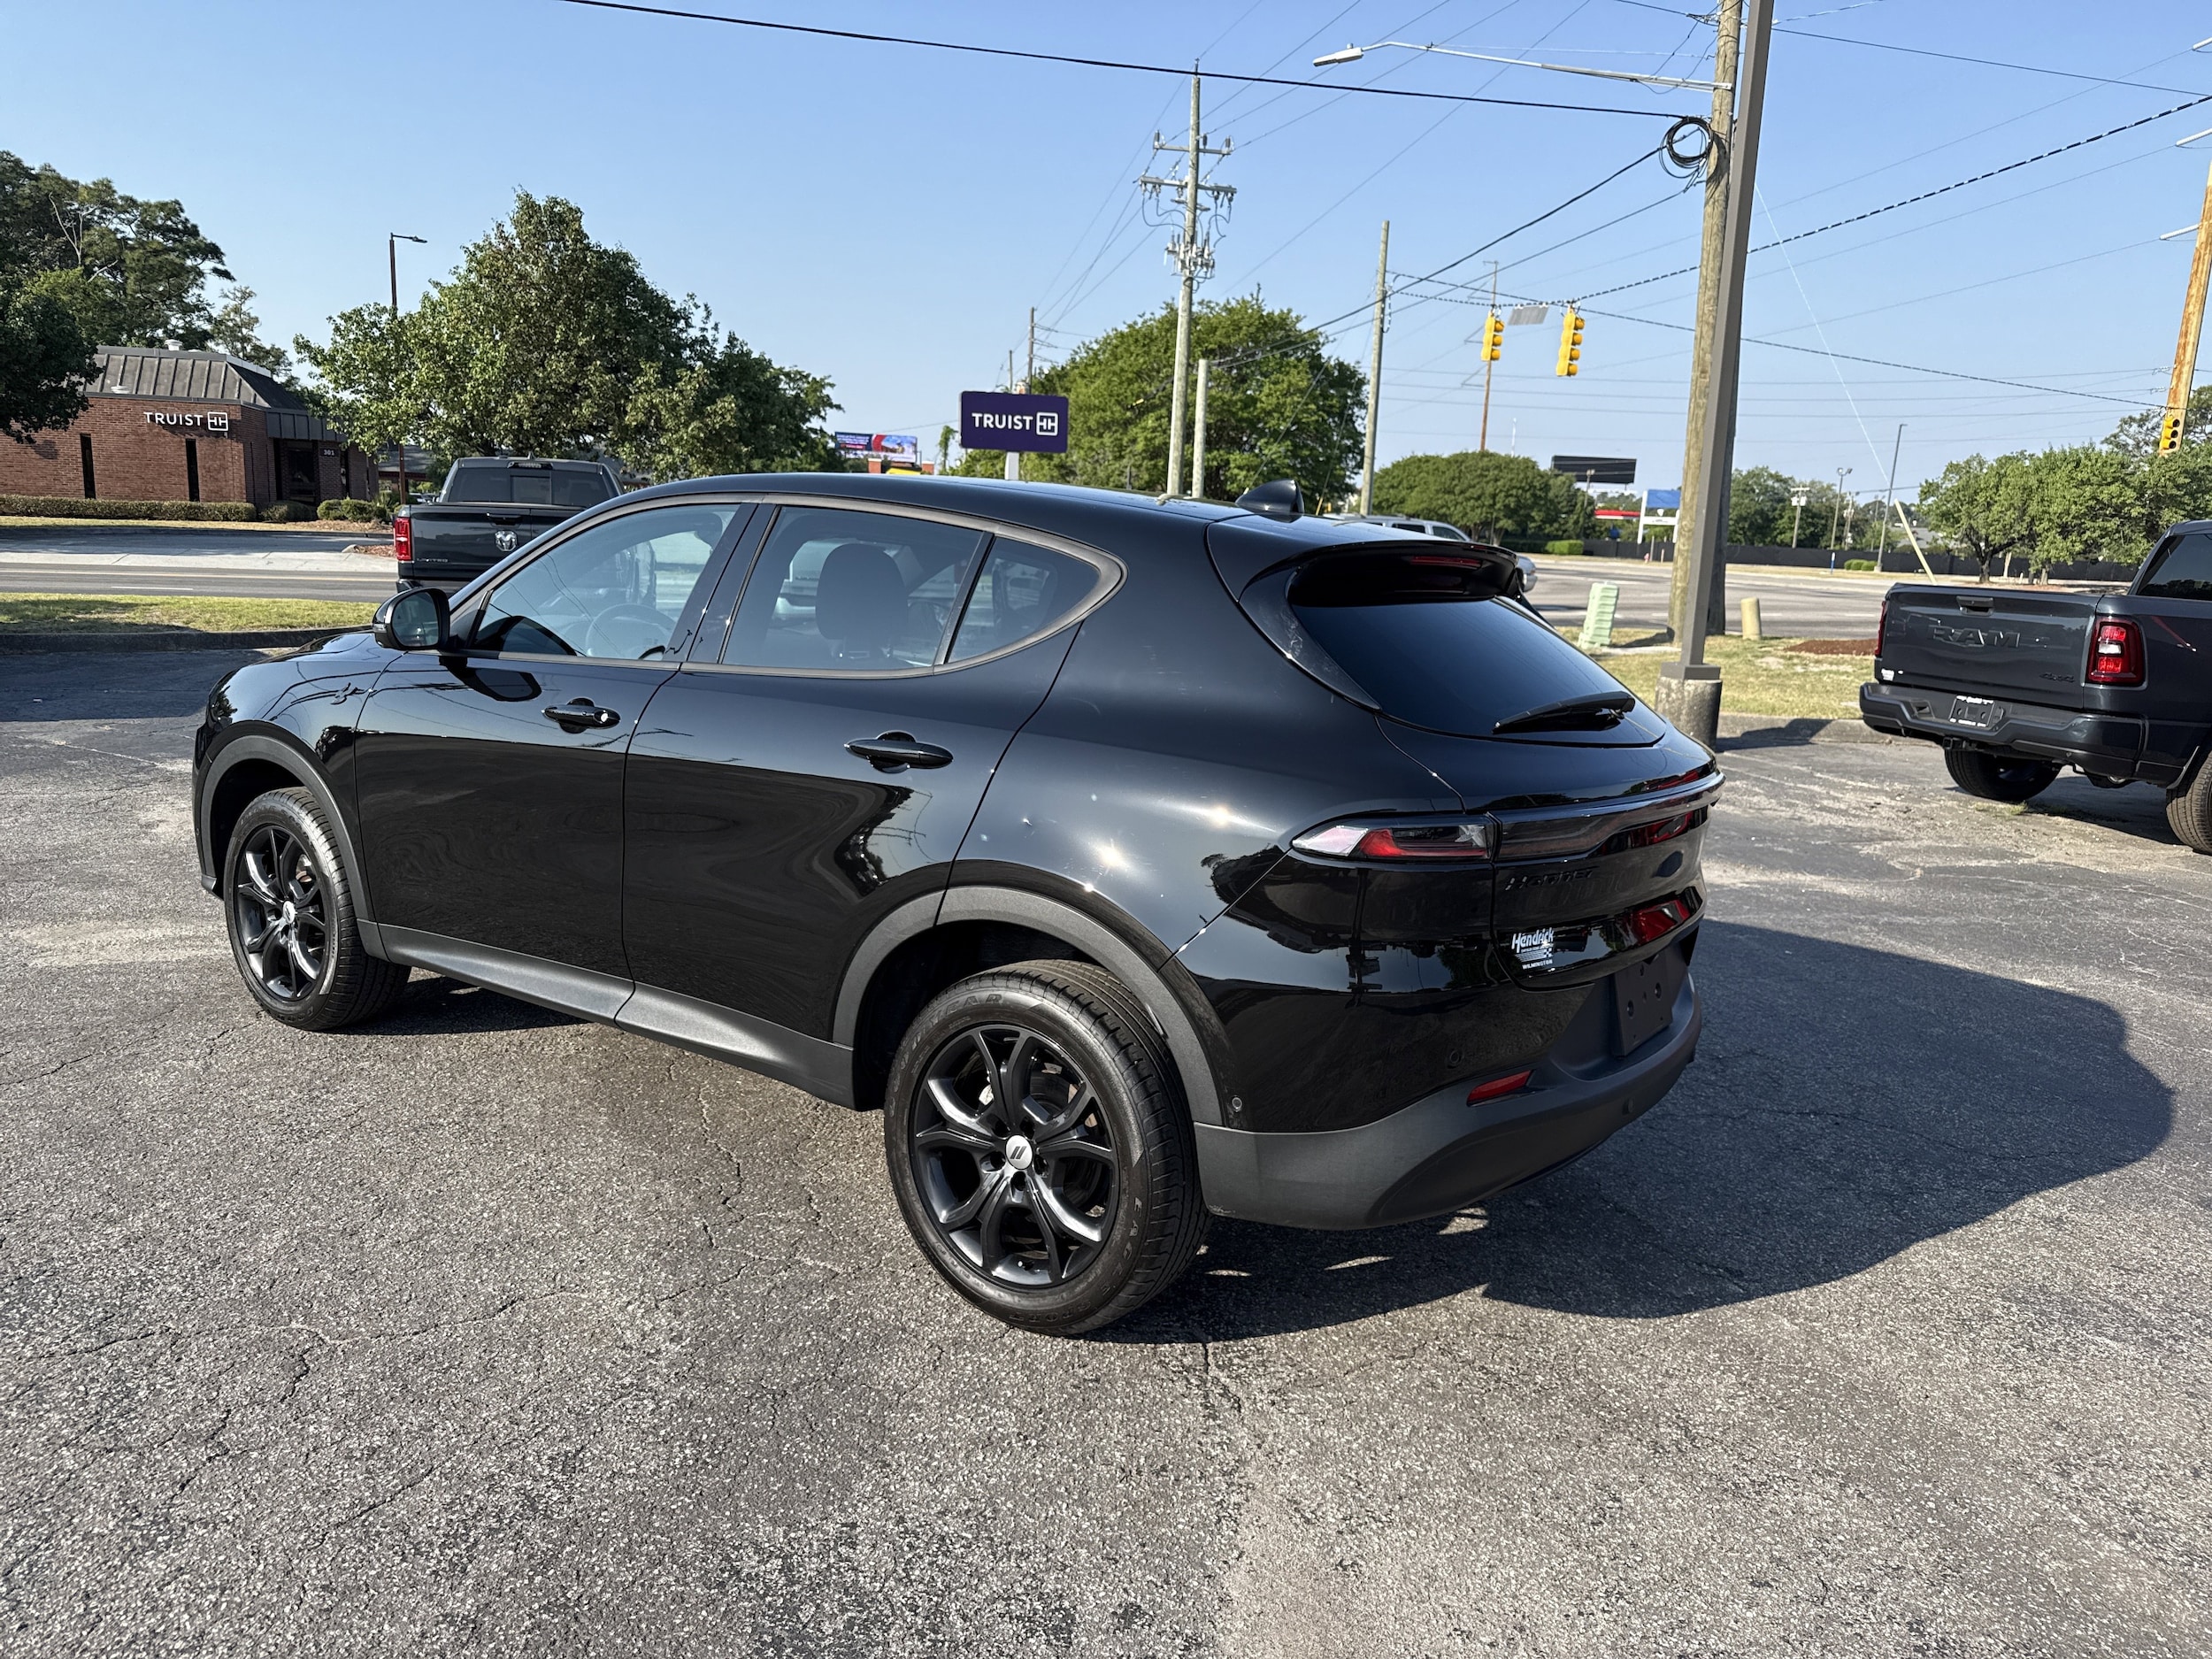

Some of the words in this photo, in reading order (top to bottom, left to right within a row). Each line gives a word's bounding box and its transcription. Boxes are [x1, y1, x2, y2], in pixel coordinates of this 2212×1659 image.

[143, 411, 204, 426] TRUIST
[972, 412, 1033, 430] TRUIST
[1928, 625, 2021, 648] RAM
[1511, 926, 1555, 954] Hendrick
[1522, 959, 1553, 970] WILMINGTON
